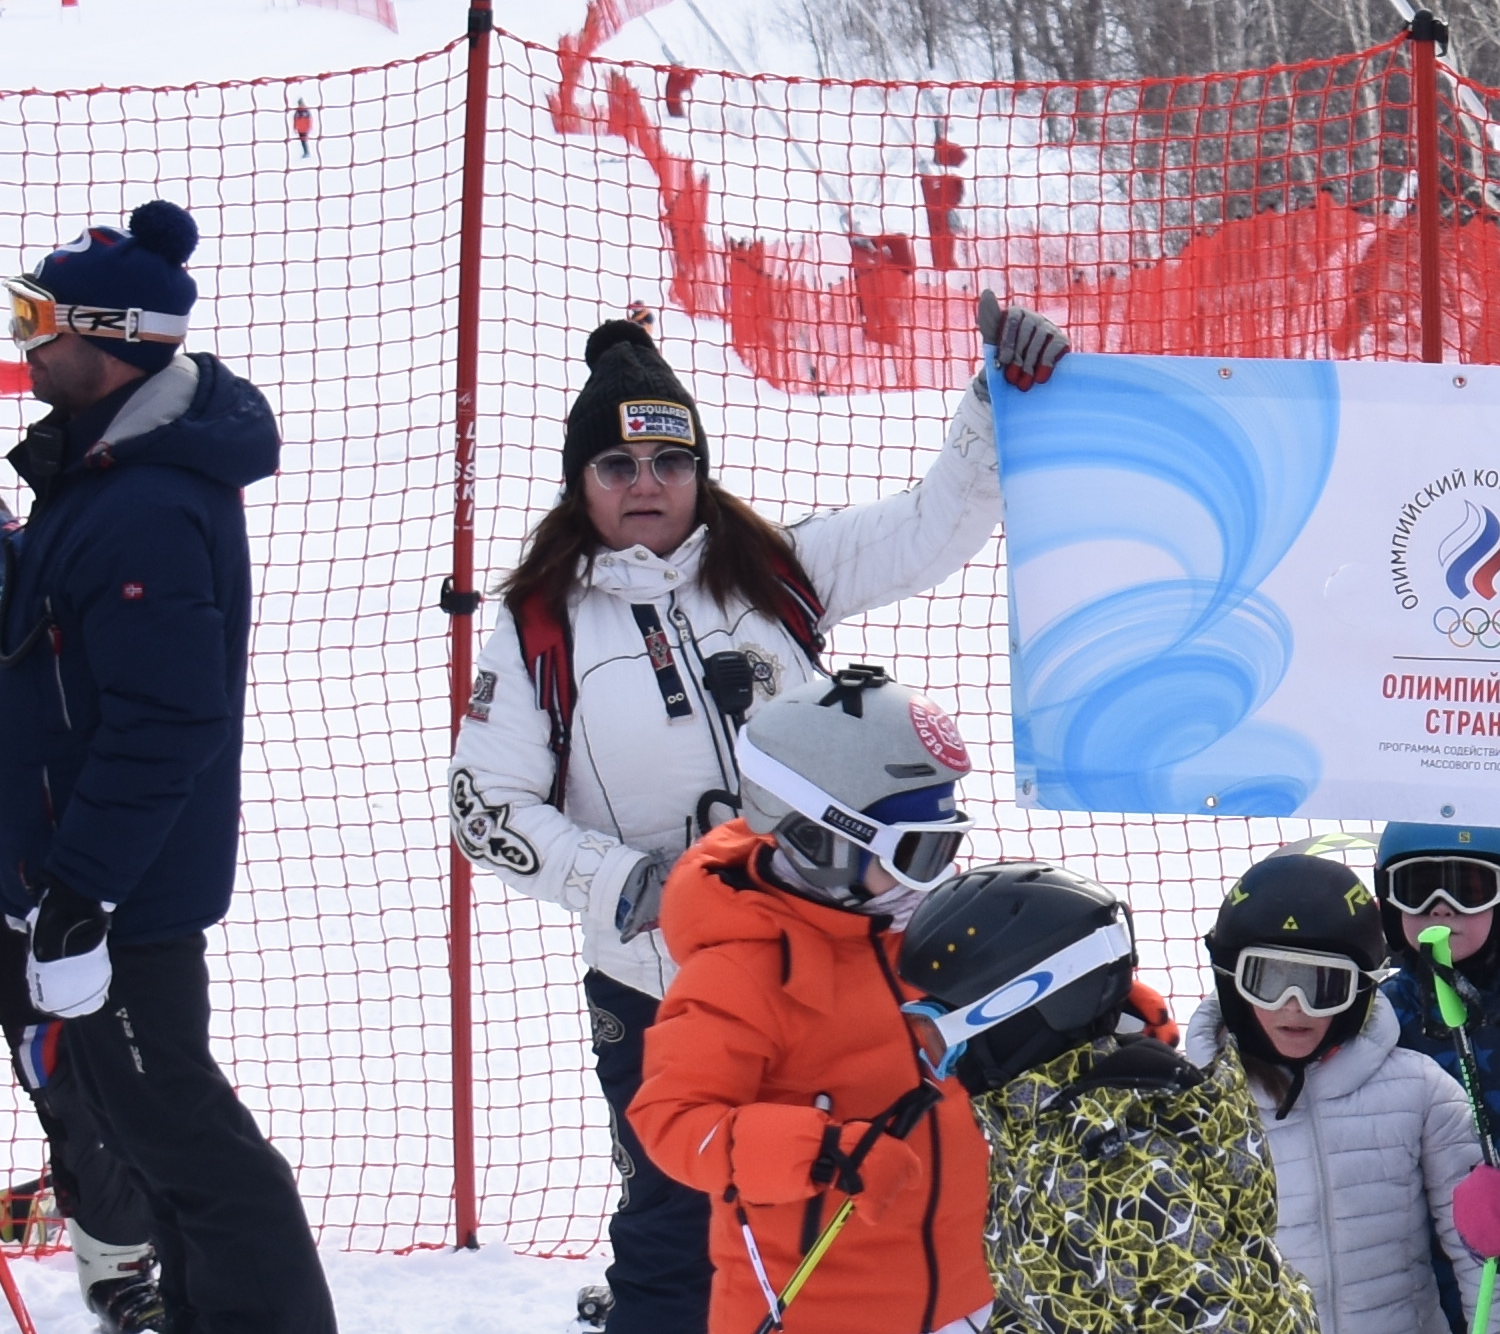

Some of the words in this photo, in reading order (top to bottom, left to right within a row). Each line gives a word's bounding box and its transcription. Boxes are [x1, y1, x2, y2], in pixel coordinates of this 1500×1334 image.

[1390, 467, 1467, 610] ОЛИМПИЙСКИЙ
[1378, 741, 1441, 755] ПРОГРАММА
[1420, 758, 1481, 773] МАССОВОГО
